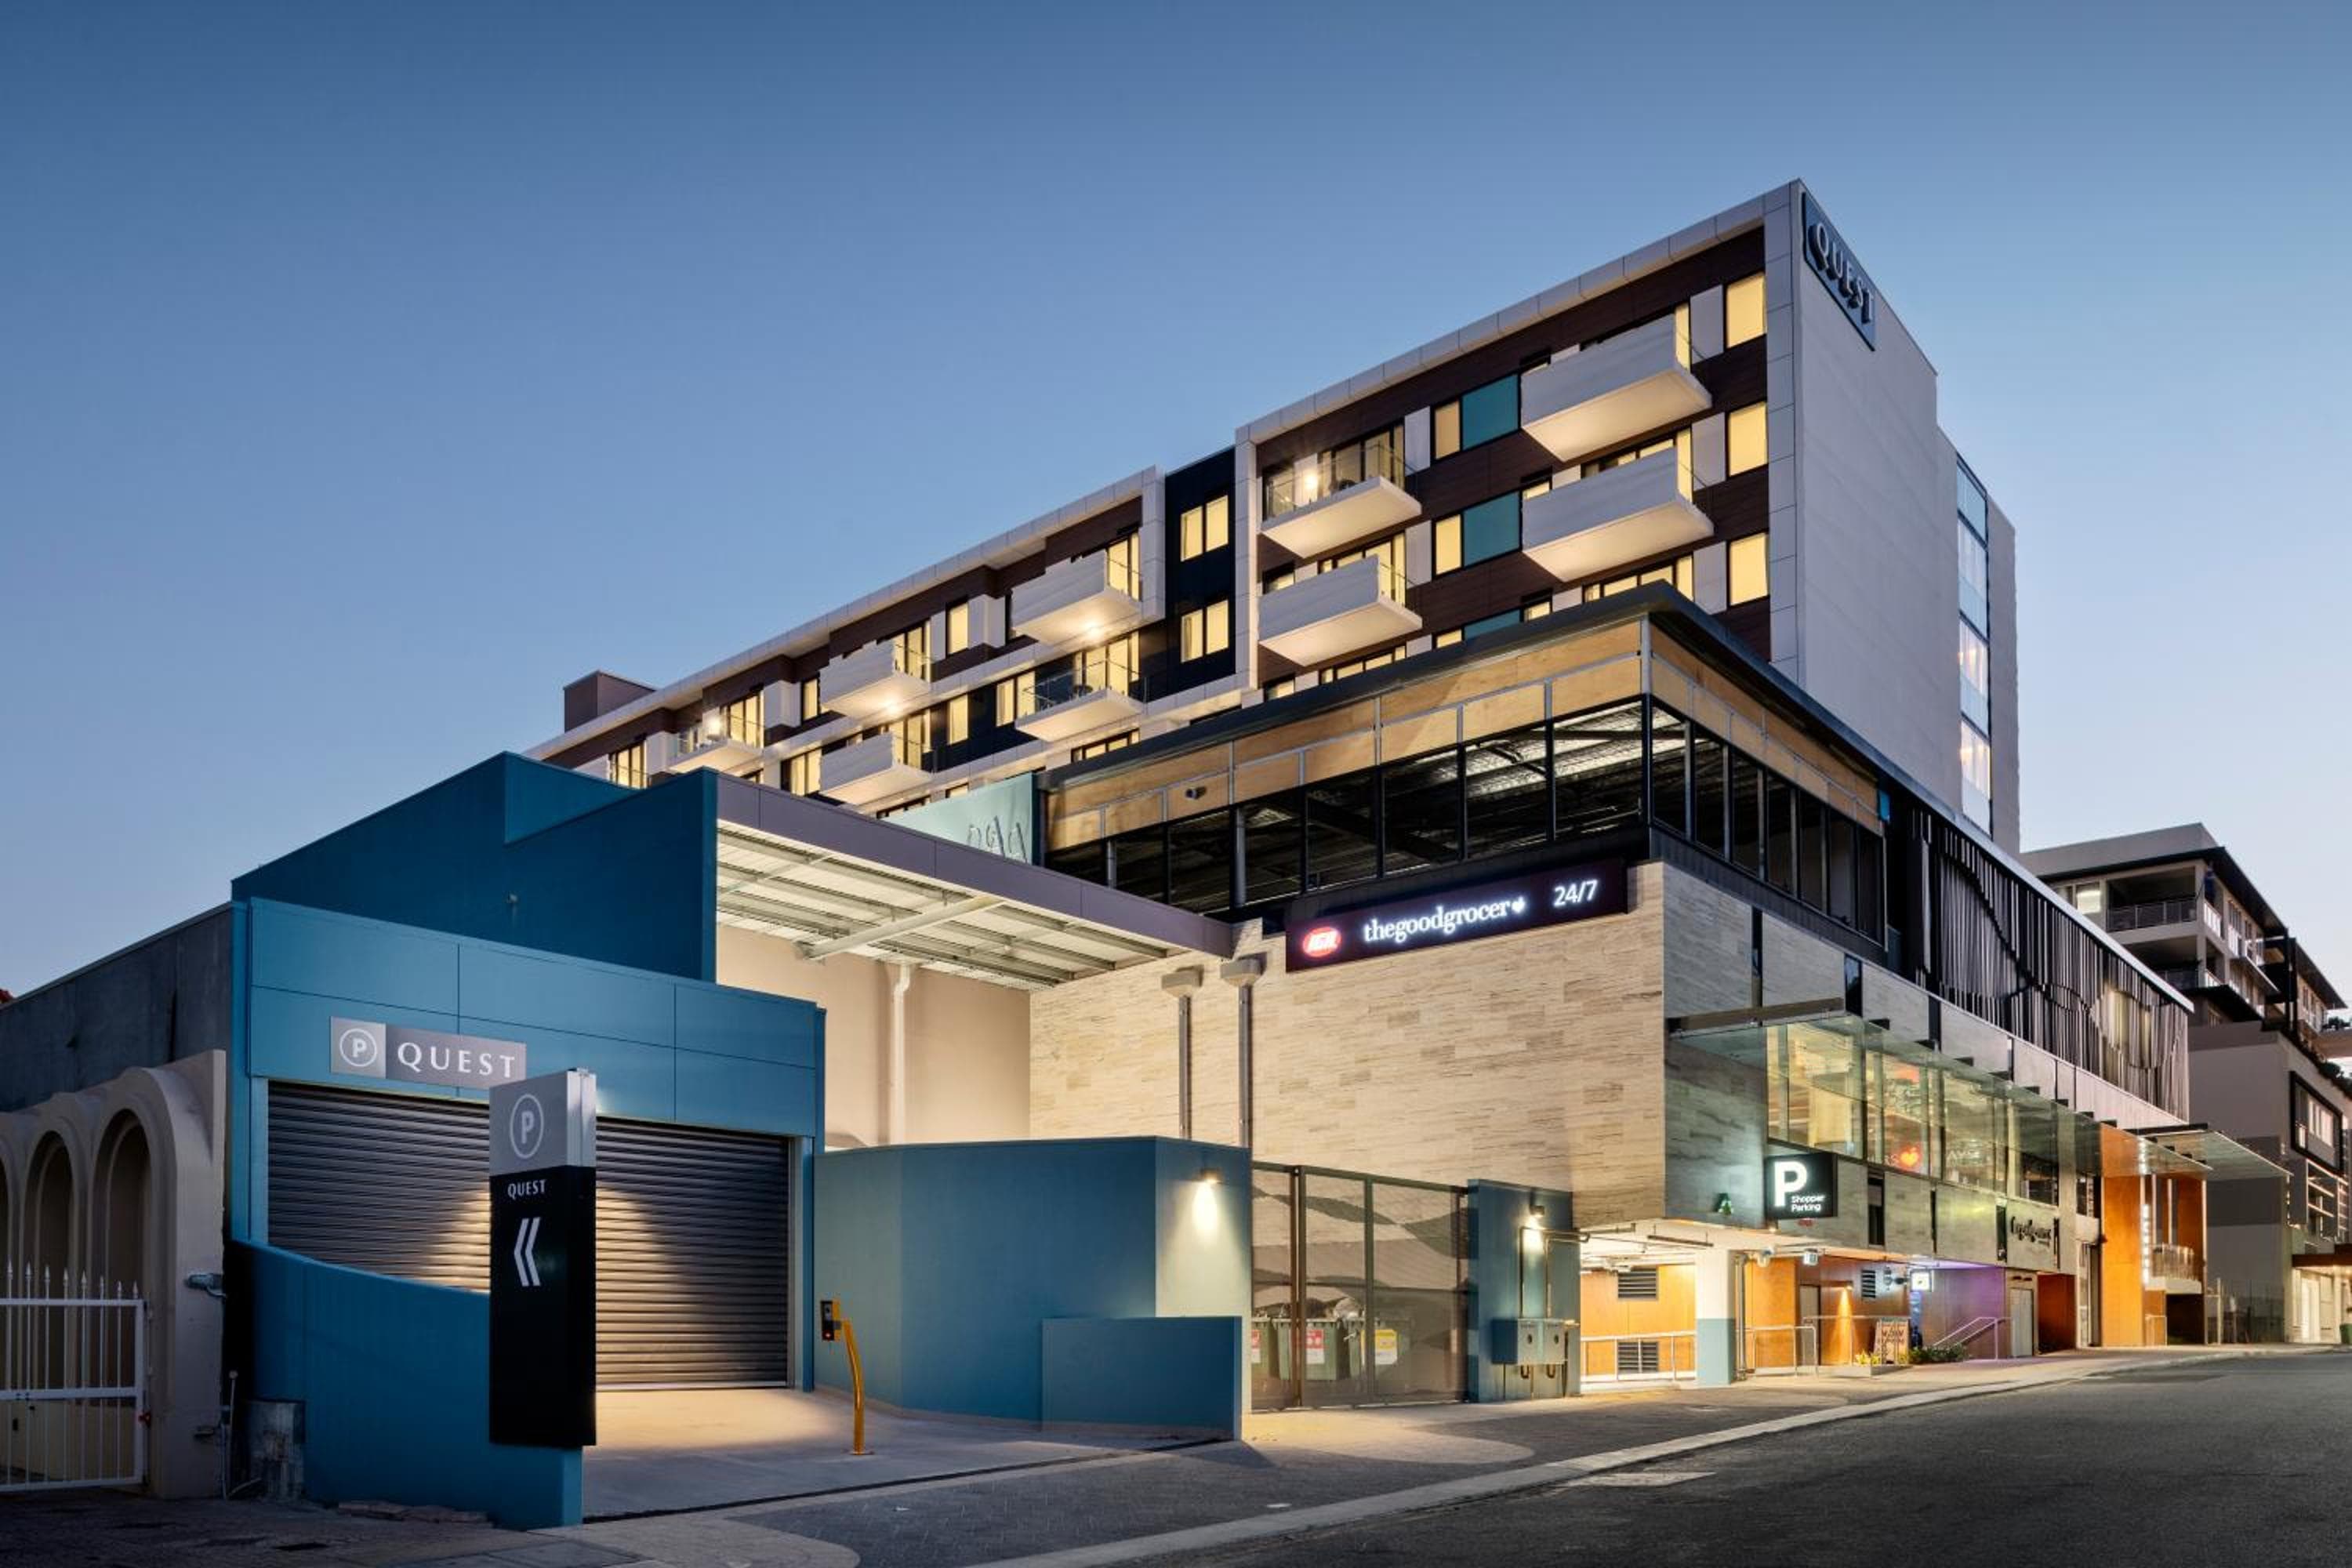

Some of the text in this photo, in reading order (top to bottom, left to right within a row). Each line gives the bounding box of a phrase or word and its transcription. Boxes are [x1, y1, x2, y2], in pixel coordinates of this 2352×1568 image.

[1809, 222, 1875, 324] QUEST
[1364, 901, 1510, 942] thegoodgrocer
[1554, 879, 1598, 906] 24/7
[352, 1039, 367, 1058] P
[397, 1042, 515, 1077] QUEST
[521, 1110, 534, 1145] P
[507, 1179, 546, 1200] QUEST
[1774, 1160, 1807, 1207] P
[1791, 1203, 1821, 1213] Parking
